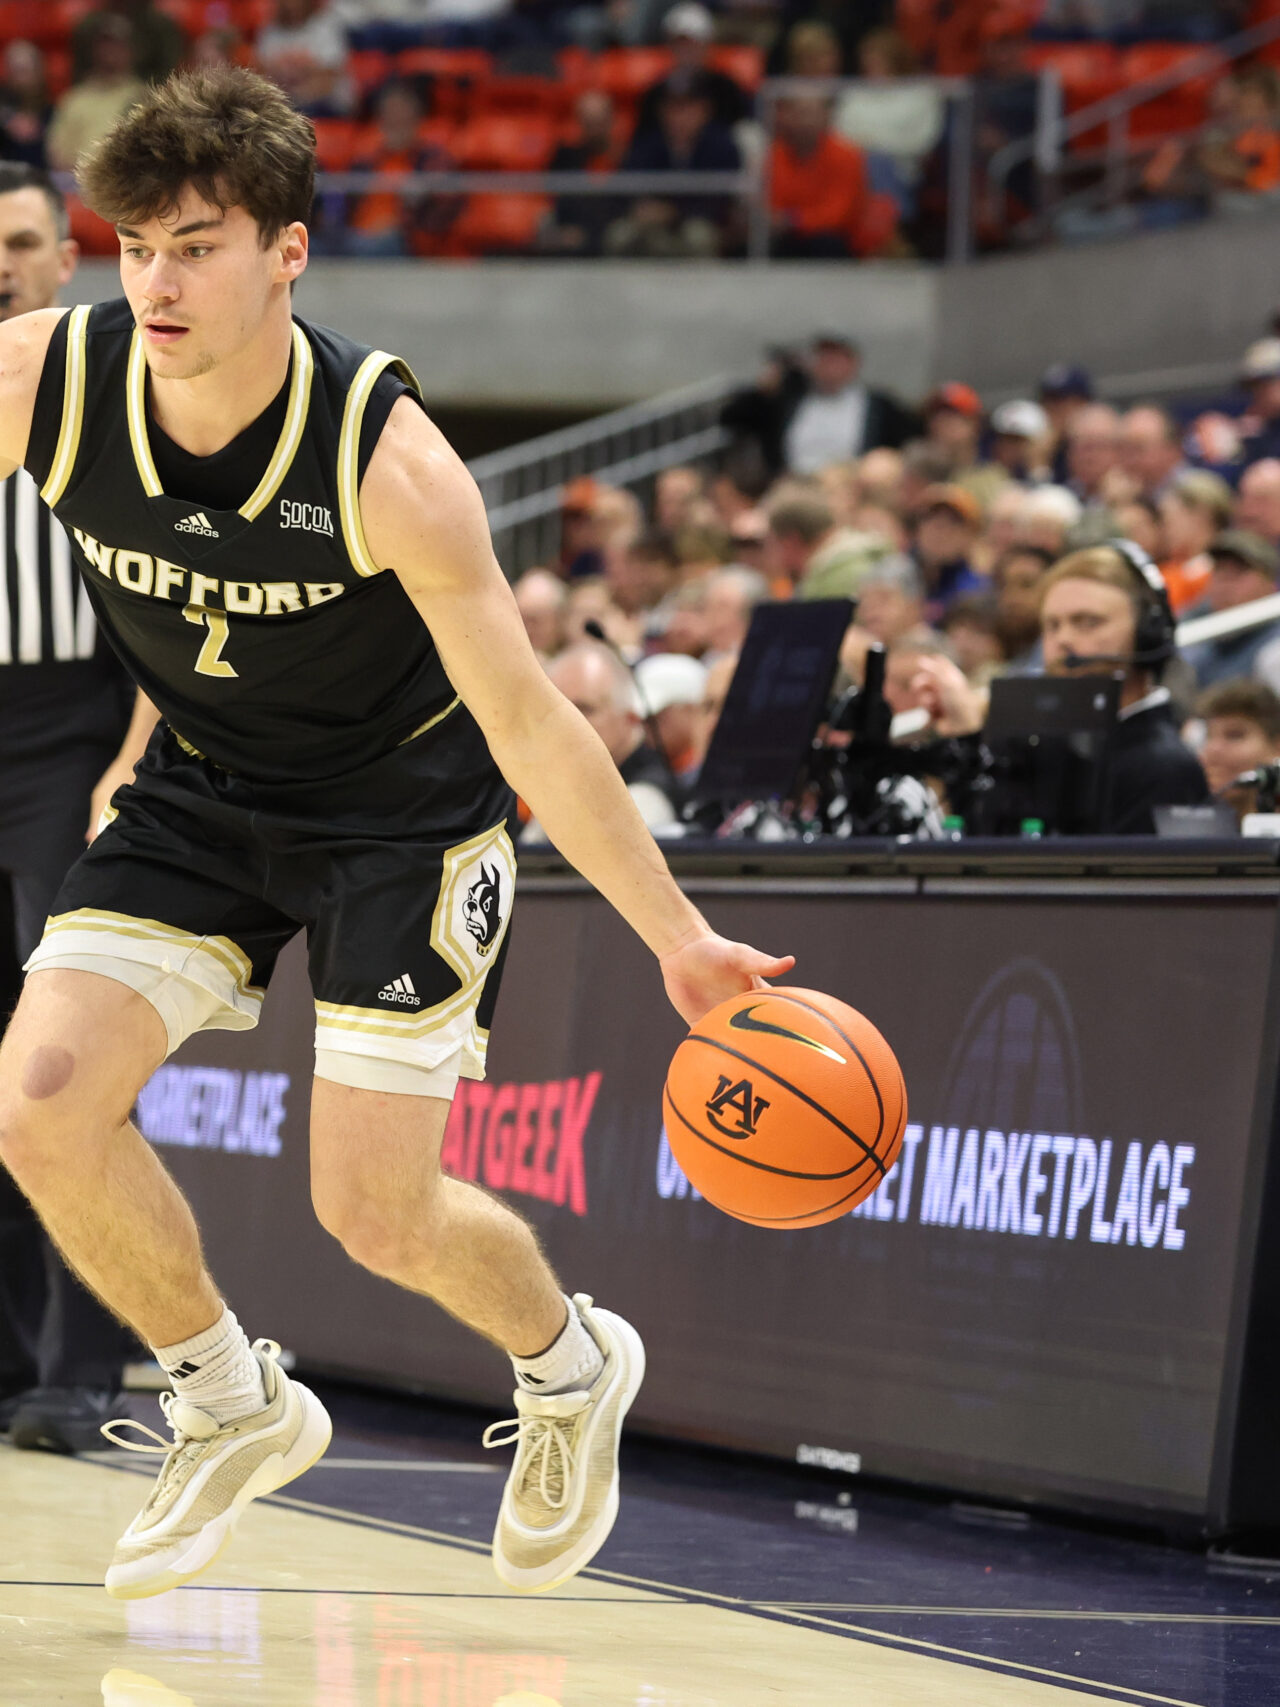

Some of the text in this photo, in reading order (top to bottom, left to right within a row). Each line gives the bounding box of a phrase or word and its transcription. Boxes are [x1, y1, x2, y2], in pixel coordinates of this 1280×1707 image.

[173, 521, 220, 538] adidas
[73, 527, 345, 615] WOFFORD
[181, 603, 240, 678] 2
[377, 990, 421, 1006] adidas
[920, 1125, 1196, 1250] MARKETPLACE
